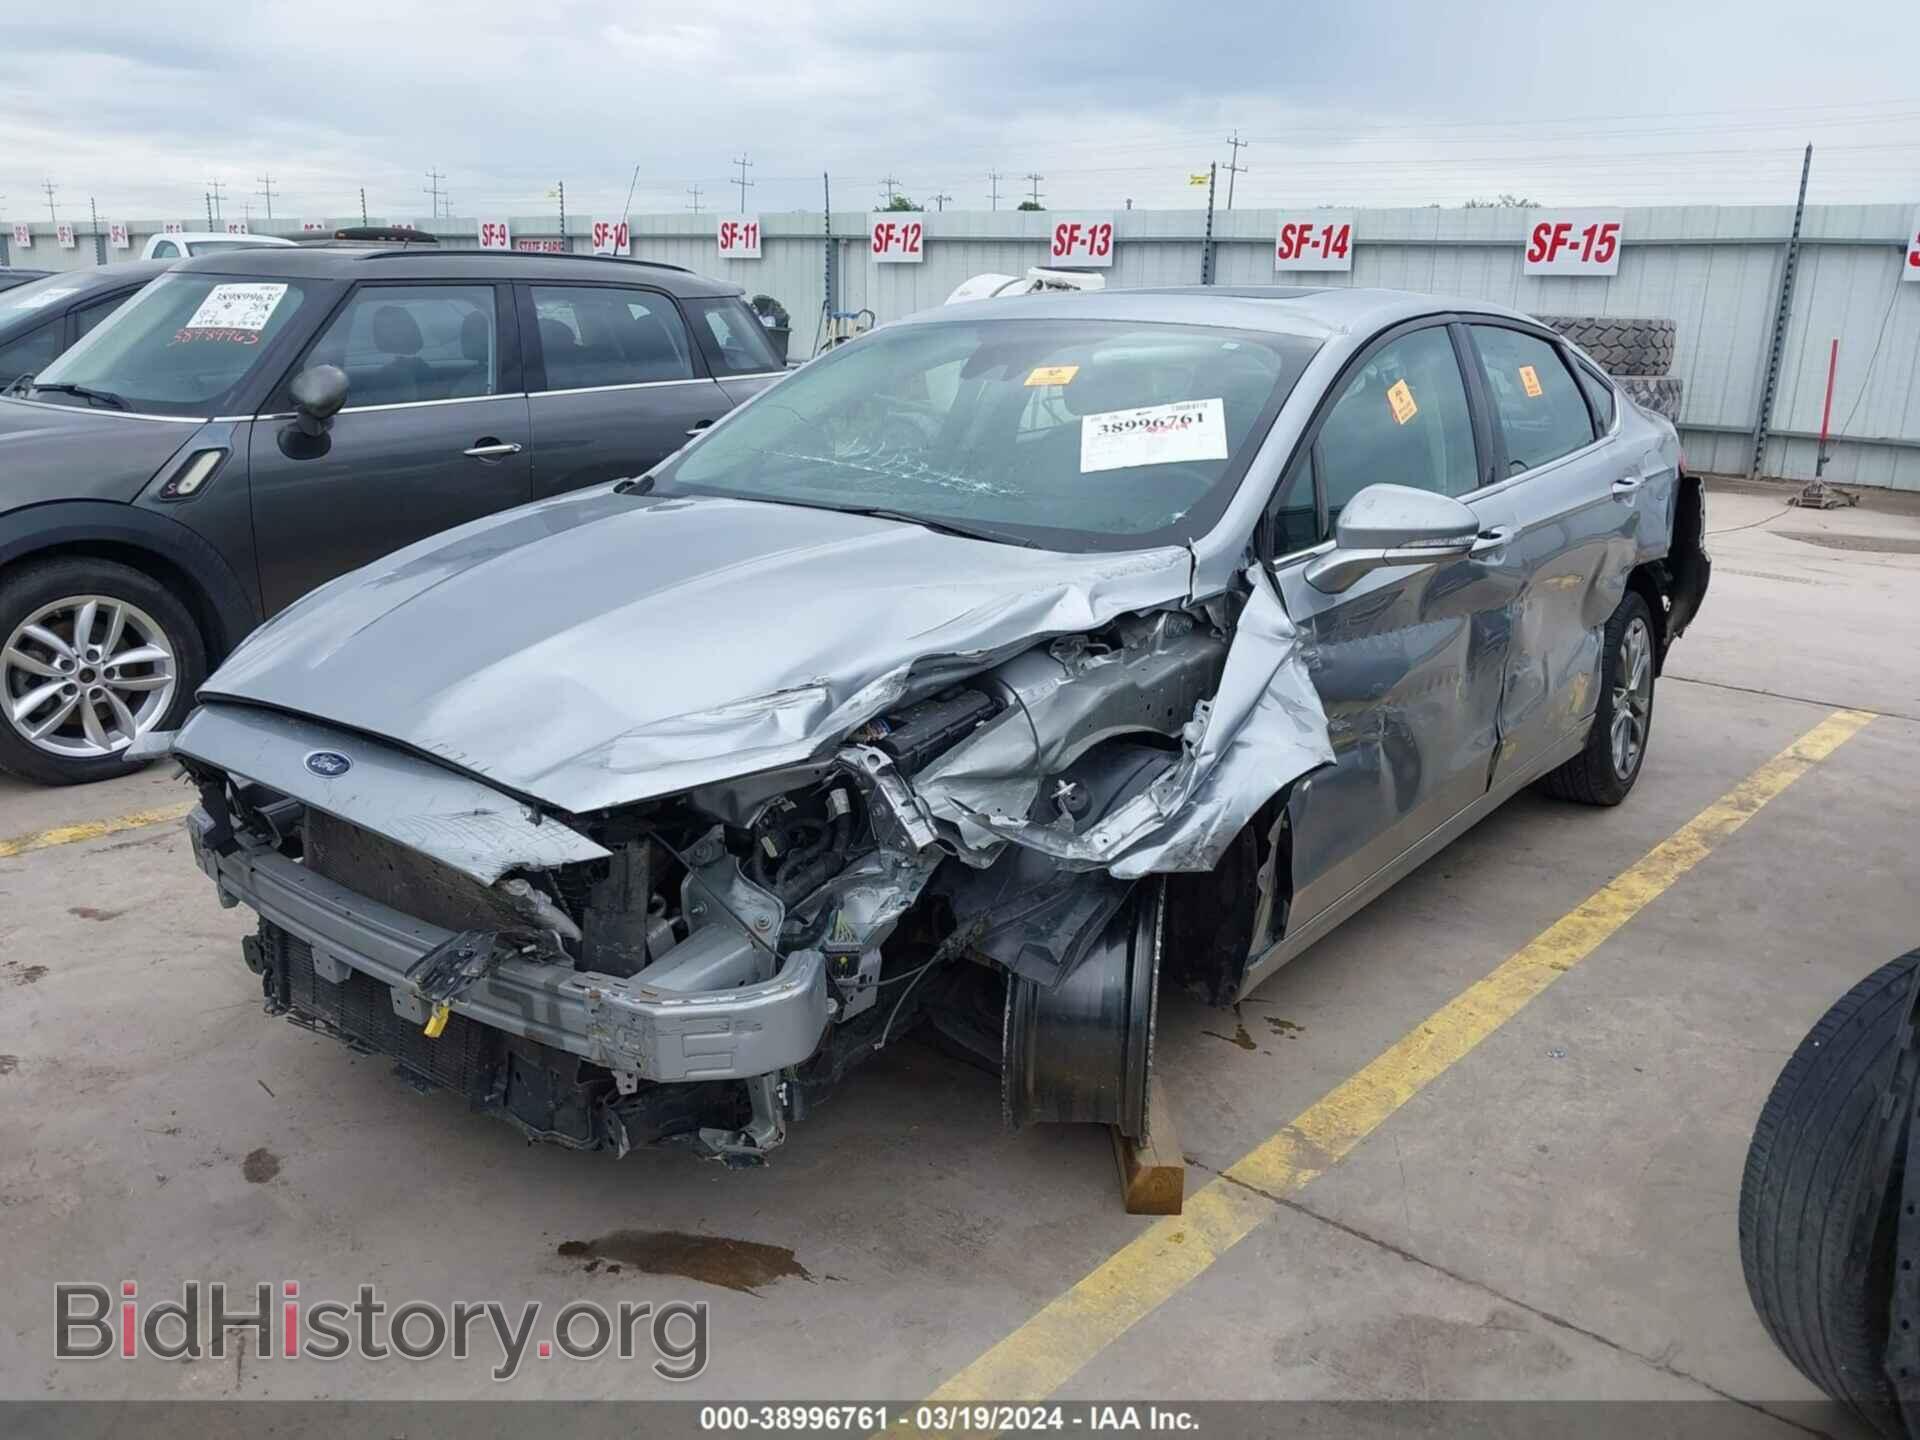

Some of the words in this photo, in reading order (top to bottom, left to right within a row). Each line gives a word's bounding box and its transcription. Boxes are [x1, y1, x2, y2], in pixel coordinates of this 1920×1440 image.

[482, 223, 506, 246] SF-9
[594, 222, 628, 247] SF-10
[720, 222, 758, 250] SF-11
[872, 223, 922, 254] SF-12
[1052, 223, 1113, 257] SF-13
[1277, 223, 1351, 260] SF-14
[1526, 222, 1621, 264] SF-15
[1097, 412, 1205, 435] 38996761
